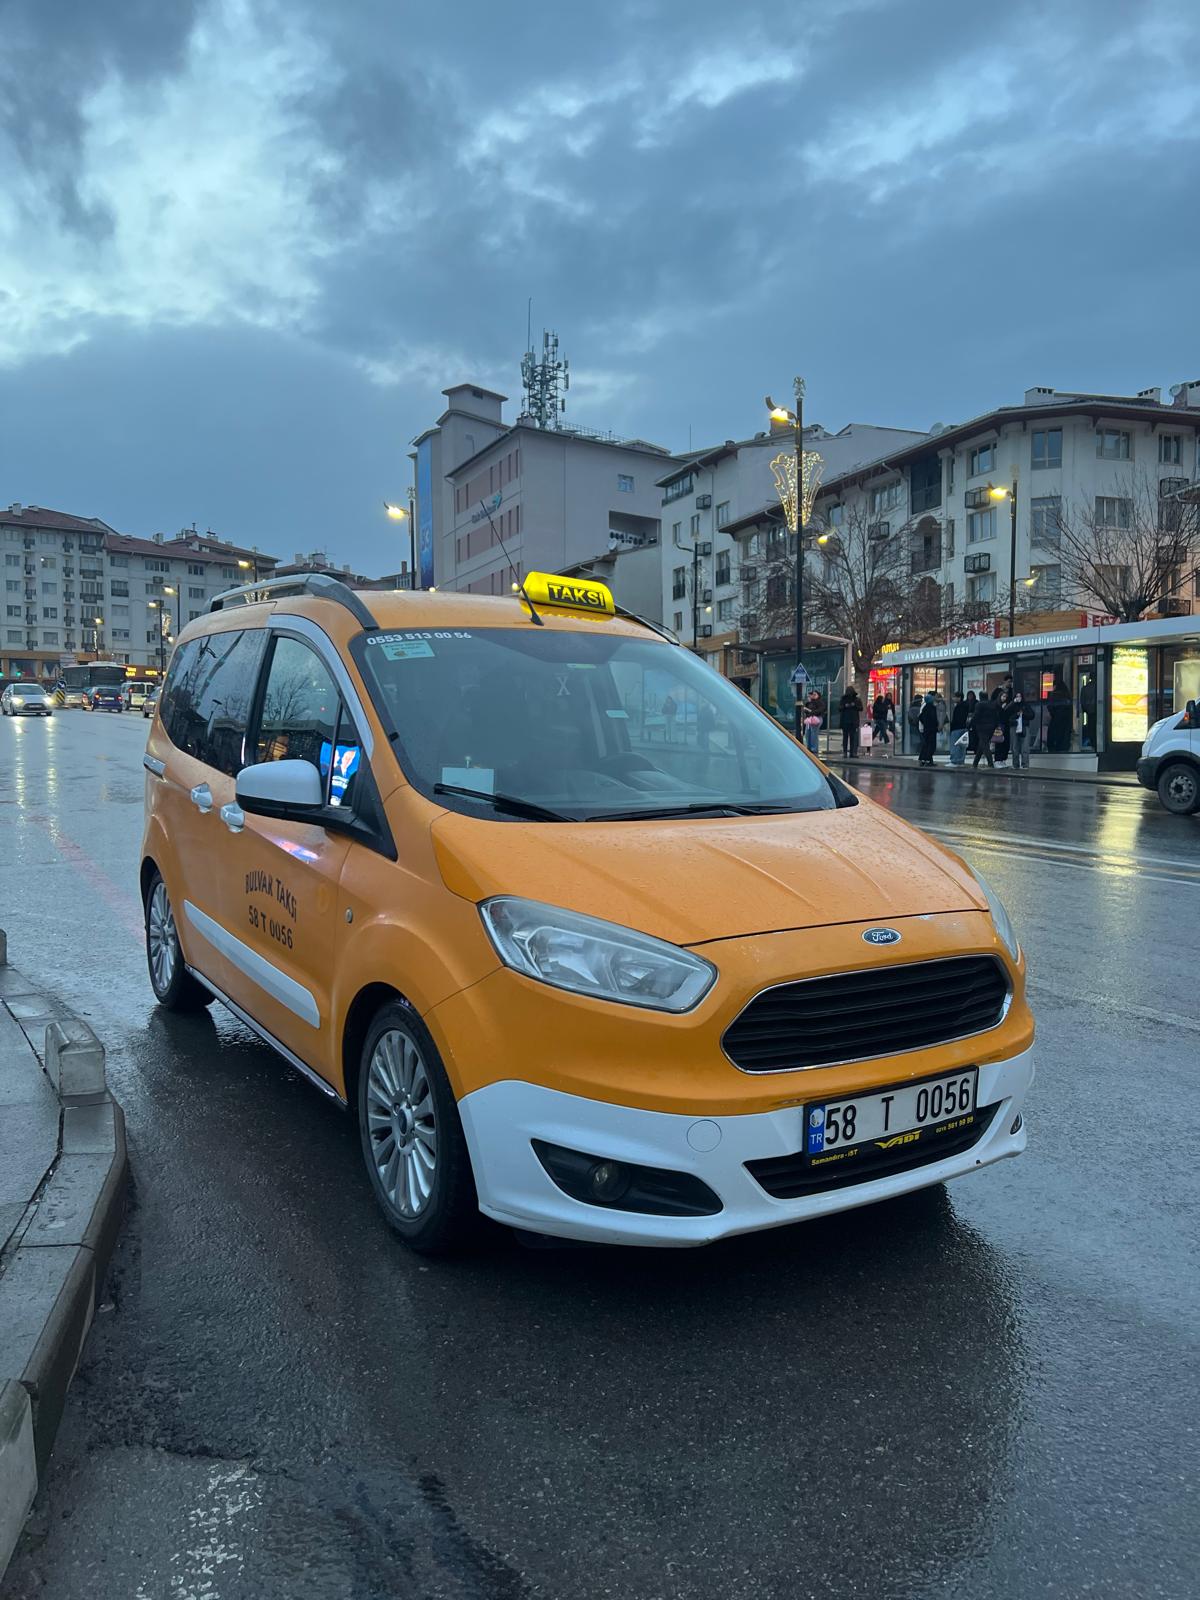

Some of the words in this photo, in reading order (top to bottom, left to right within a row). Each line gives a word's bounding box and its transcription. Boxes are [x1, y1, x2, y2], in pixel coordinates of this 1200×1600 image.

[367, 634, 403, 645] 0553
[404, 632, 432, 640] 513
[248, 905, 259, 928] 58
[260, 912, 267, 933] T
[269, 918, 293, 949] 0056
[872, 931, 893, 942] Ford
[825, 1104, 857, 1145] 58
[881, 1096, 895, 1131] T
[916, 1078, 970, 1123] 0056
[810, 1133, 823, 1145] TR
